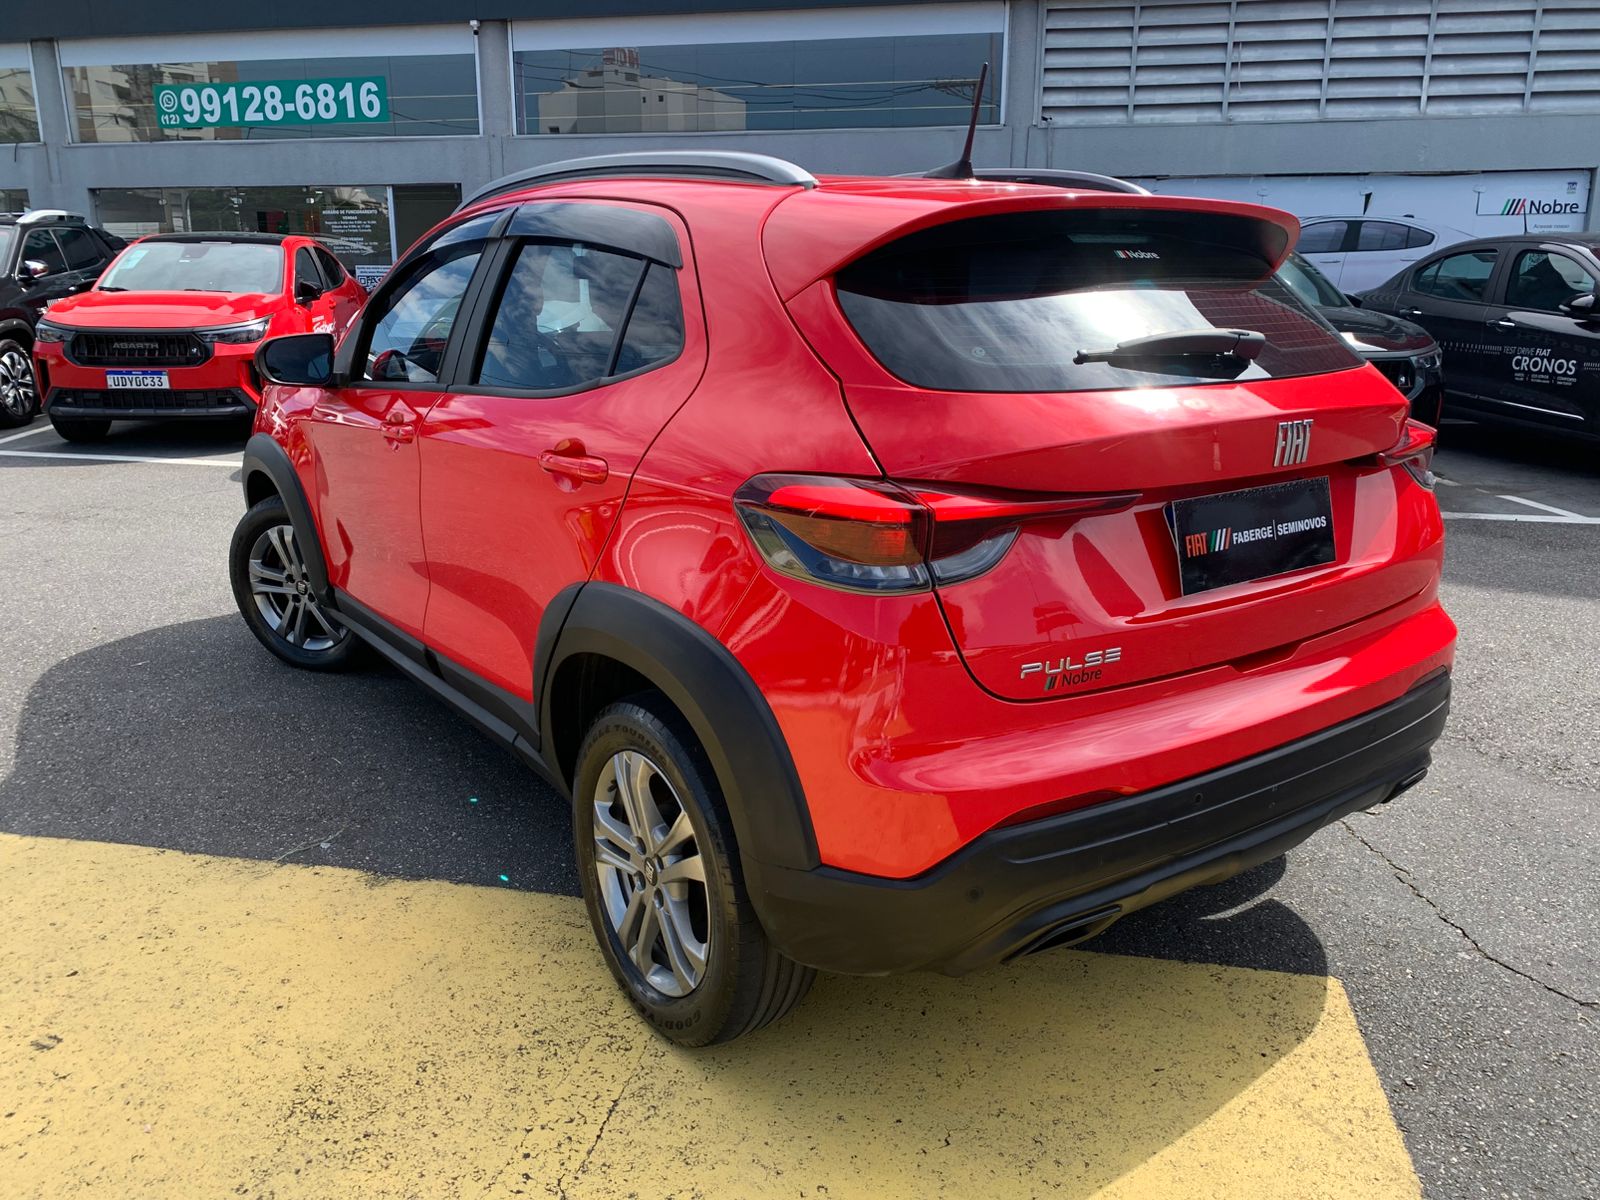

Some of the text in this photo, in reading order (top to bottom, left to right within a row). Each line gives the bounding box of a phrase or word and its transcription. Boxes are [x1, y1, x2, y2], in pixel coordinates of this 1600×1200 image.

[180, 81, 381, 124] 99128-6816
[161, 114, 180, 125] (12)
[1529, 199, 1579, 214] Nobre
[1128, 250, 1160, 259] Nobre
[1503, 345, 1517, 355] TEST
[1517, 347, 1535, 356] DRIVE
[1535, 348, 1551, 357] FIAT
[1512, 355, 1577, 375] CRONOS
[1273, 418, 1314, 467] FIAT
[1185, 532, 1207, 559] FIAT
[1020, 647, 1122, 679] PULSE
[1061, 668, 1102, 687] Nobre
